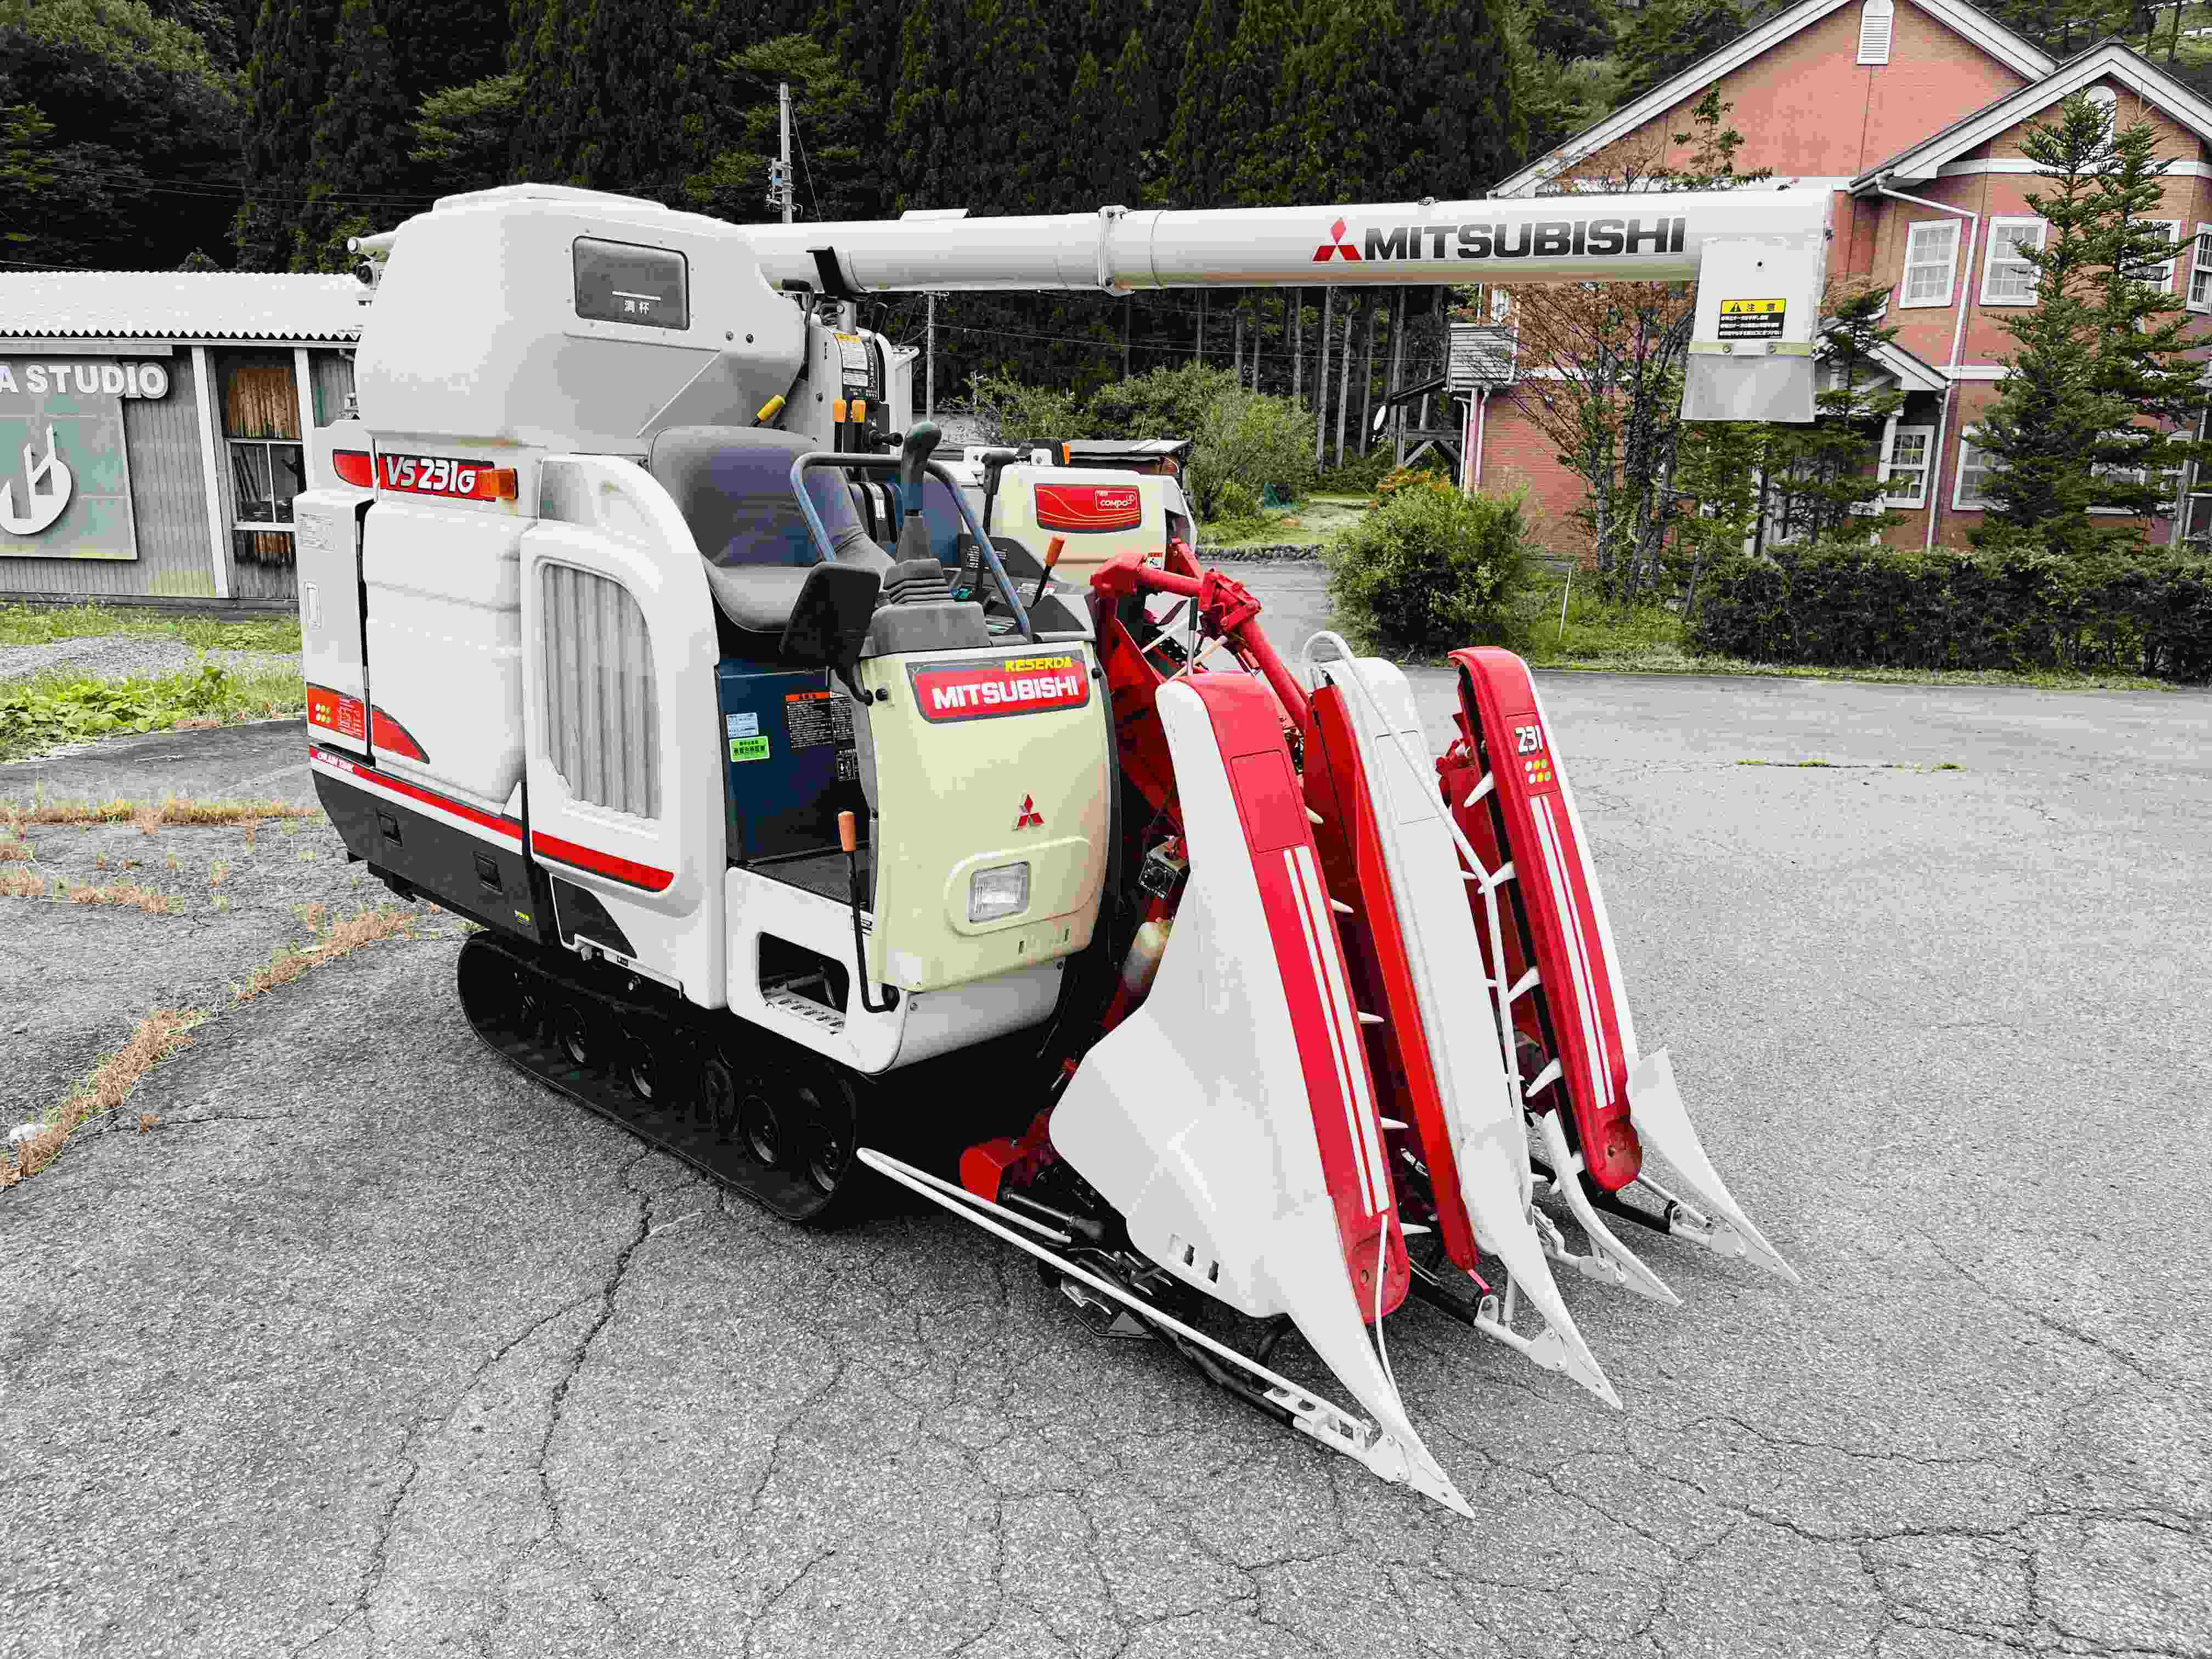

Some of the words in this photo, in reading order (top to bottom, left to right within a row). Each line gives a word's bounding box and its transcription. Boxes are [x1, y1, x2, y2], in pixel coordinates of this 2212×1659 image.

[1364, 217, 1686, 261] MITSUBISHI
[26, 363, 168, 399] STUDIO
[931, 675, 1079, 709] MITSUBISHI
